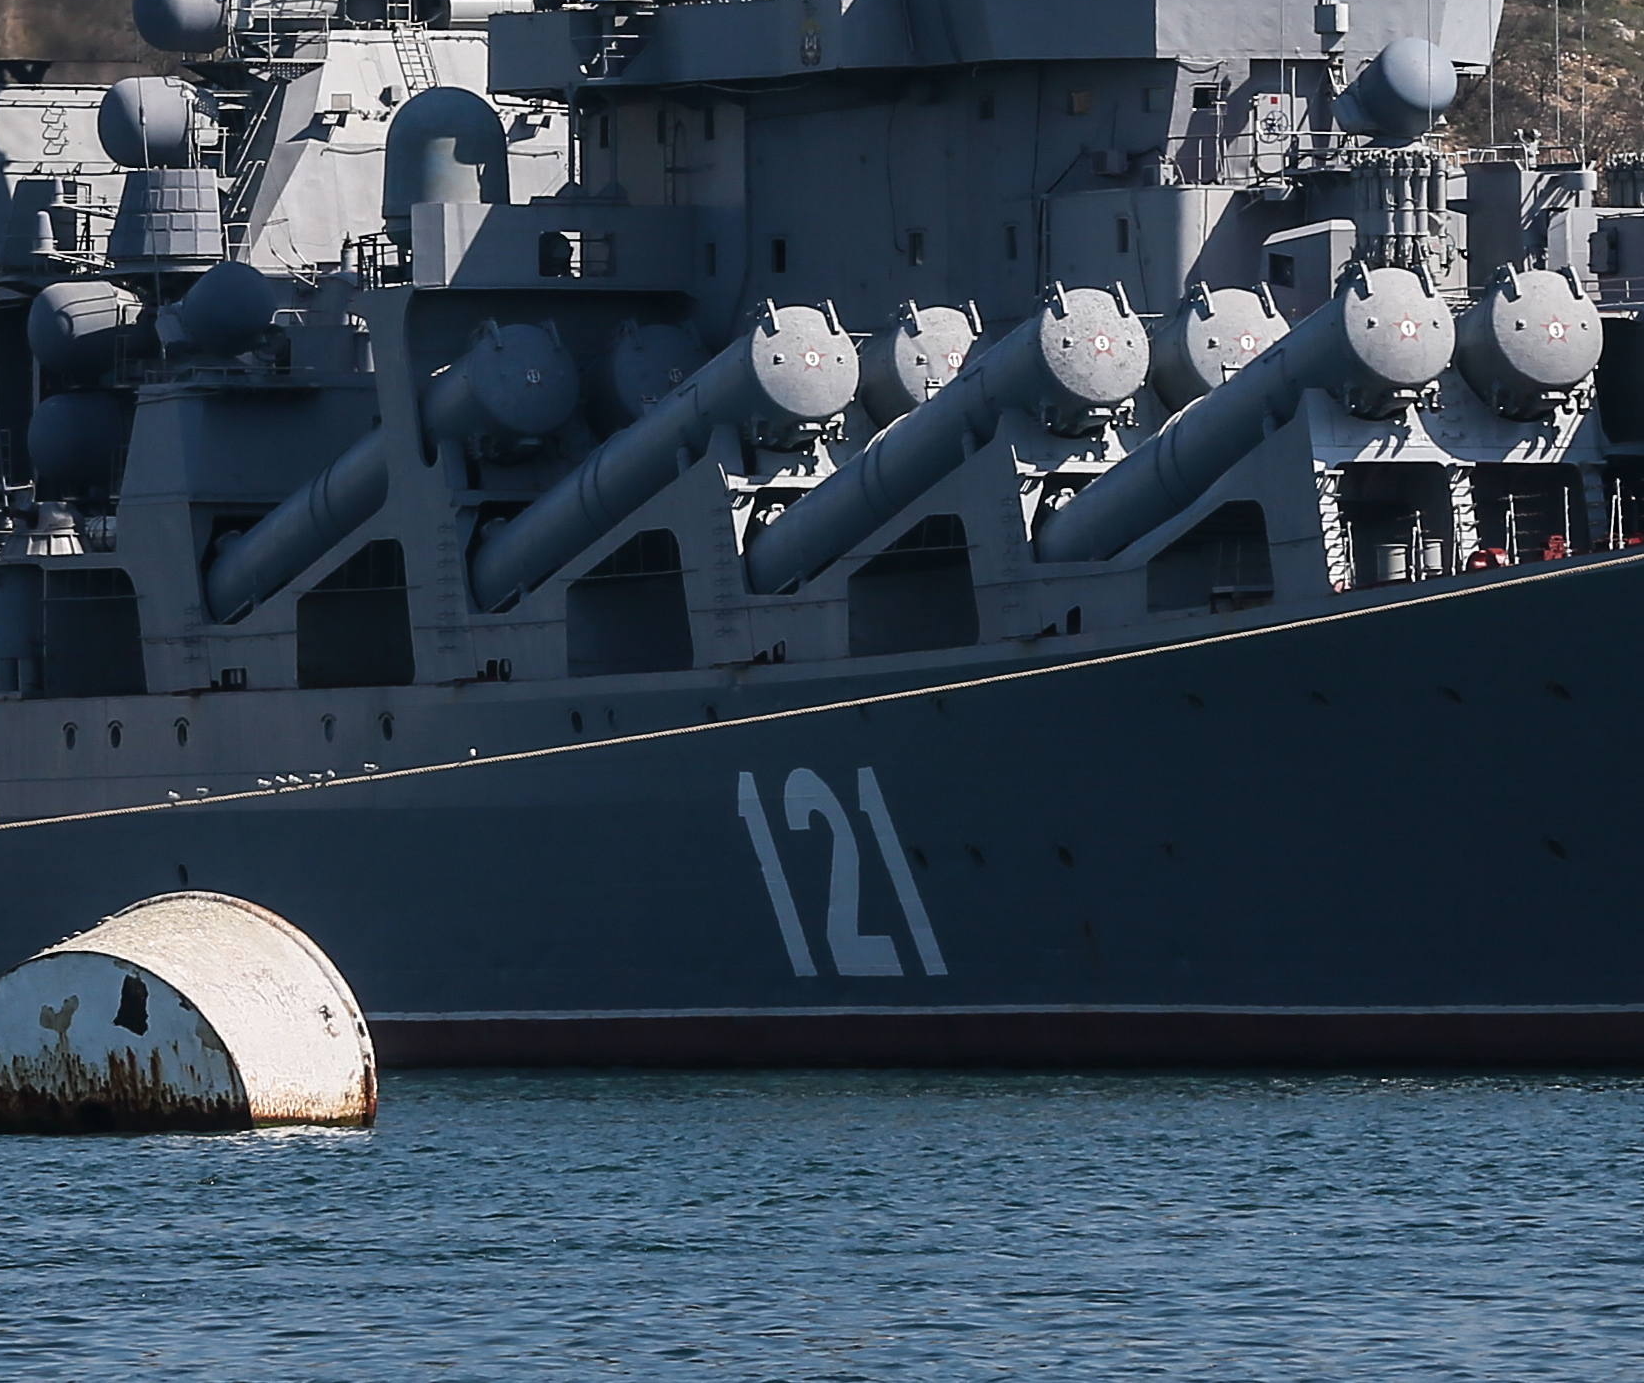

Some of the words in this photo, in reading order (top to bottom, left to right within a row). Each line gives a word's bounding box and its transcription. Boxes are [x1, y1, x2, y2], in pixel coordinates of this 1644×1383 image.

[949, 354, 960, 366] 11
[528, 371, 539, 382] 13
[671, 370, 682, 381] 15
[737, 766, 949, 977] 121
